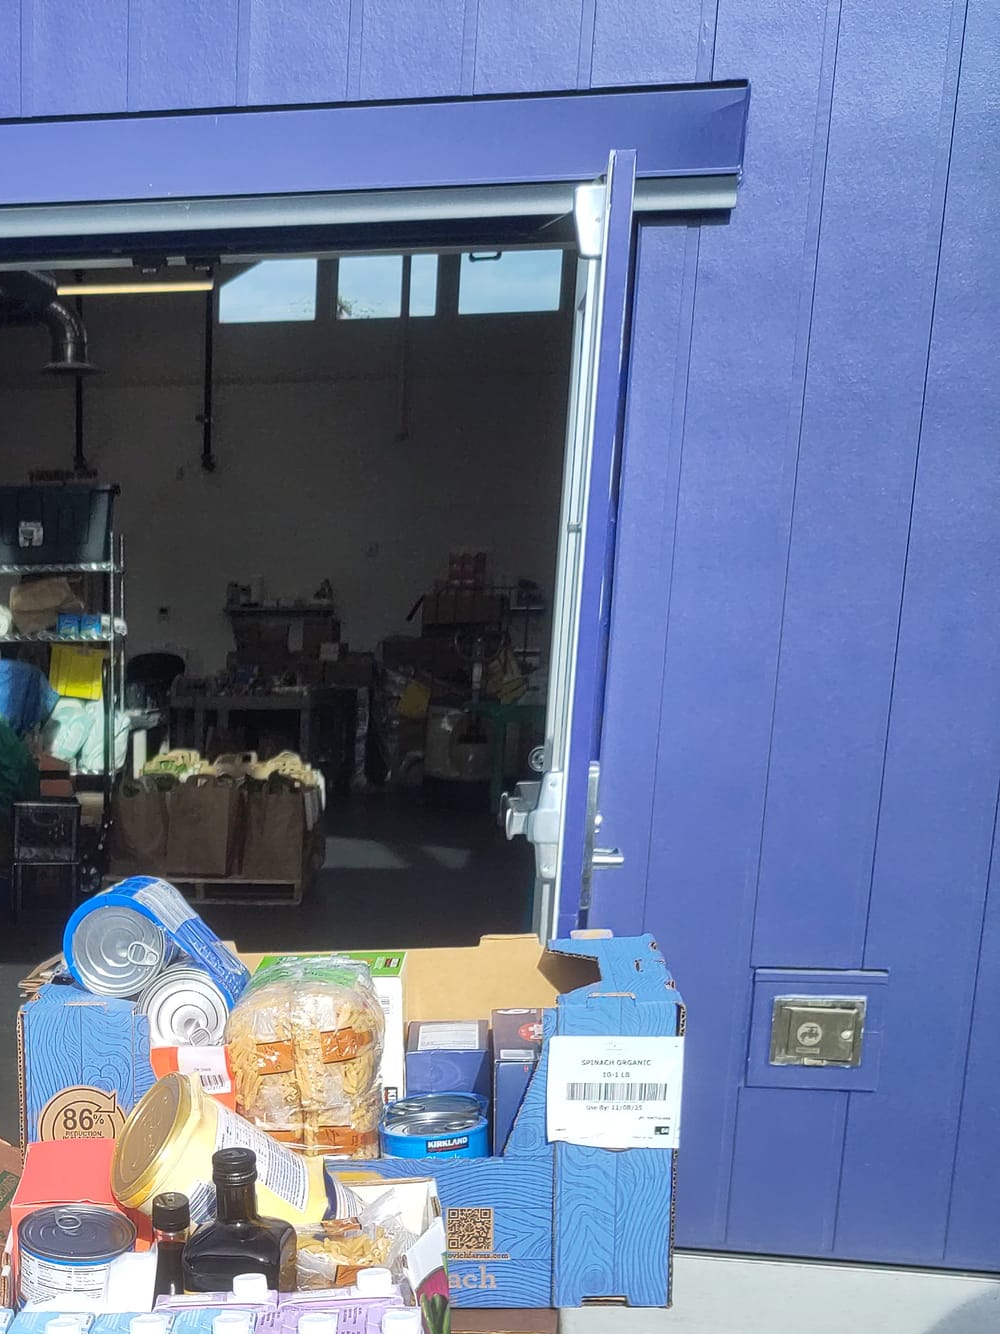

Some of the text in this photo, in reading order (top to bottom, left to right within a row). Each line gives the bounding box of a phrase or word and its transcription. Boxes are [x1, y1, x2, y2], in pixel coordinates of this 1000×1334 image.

[62, 1108, 104, 1130] 86%
[427, 1137, 469, 1149] KIRKLAND
[447, 1251, 509, 1259] ovichfarms.com
[448, 1264, 497, 1289] ach
